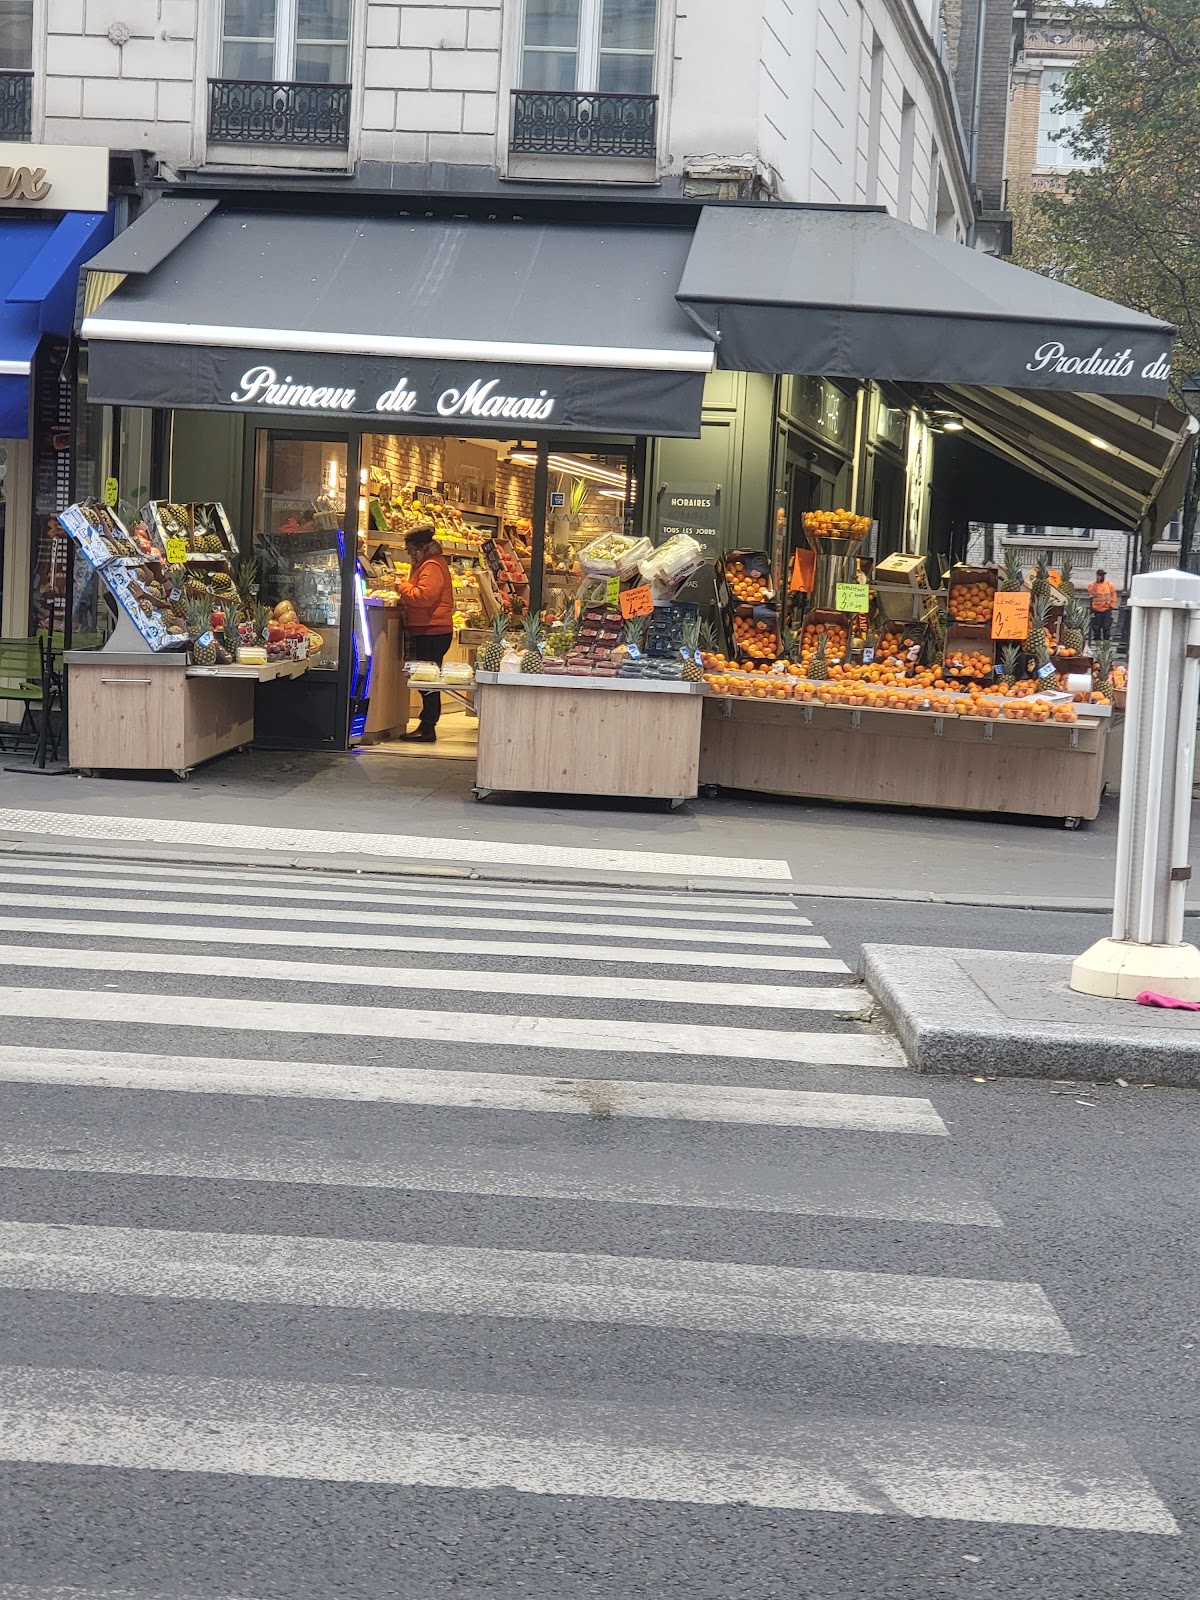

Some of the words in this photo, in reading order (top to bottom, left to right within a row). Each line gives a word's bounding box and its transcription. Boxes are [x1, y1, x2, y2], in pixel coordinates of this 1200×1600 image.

[1026, 341, 1135, 377] Produits
[1141, 352, 1171, 381] du
[231, 366, 356, 410] Primeur
[376, 377, 417, 412] du
[436, 378, 555, 419] Marais
[671, 498, 711, 507] HORAIRES
[663, 526, 680, 534] TOUS
[682, 527, 693, 535] LES
[695, 528, 716, 536] JOURS
